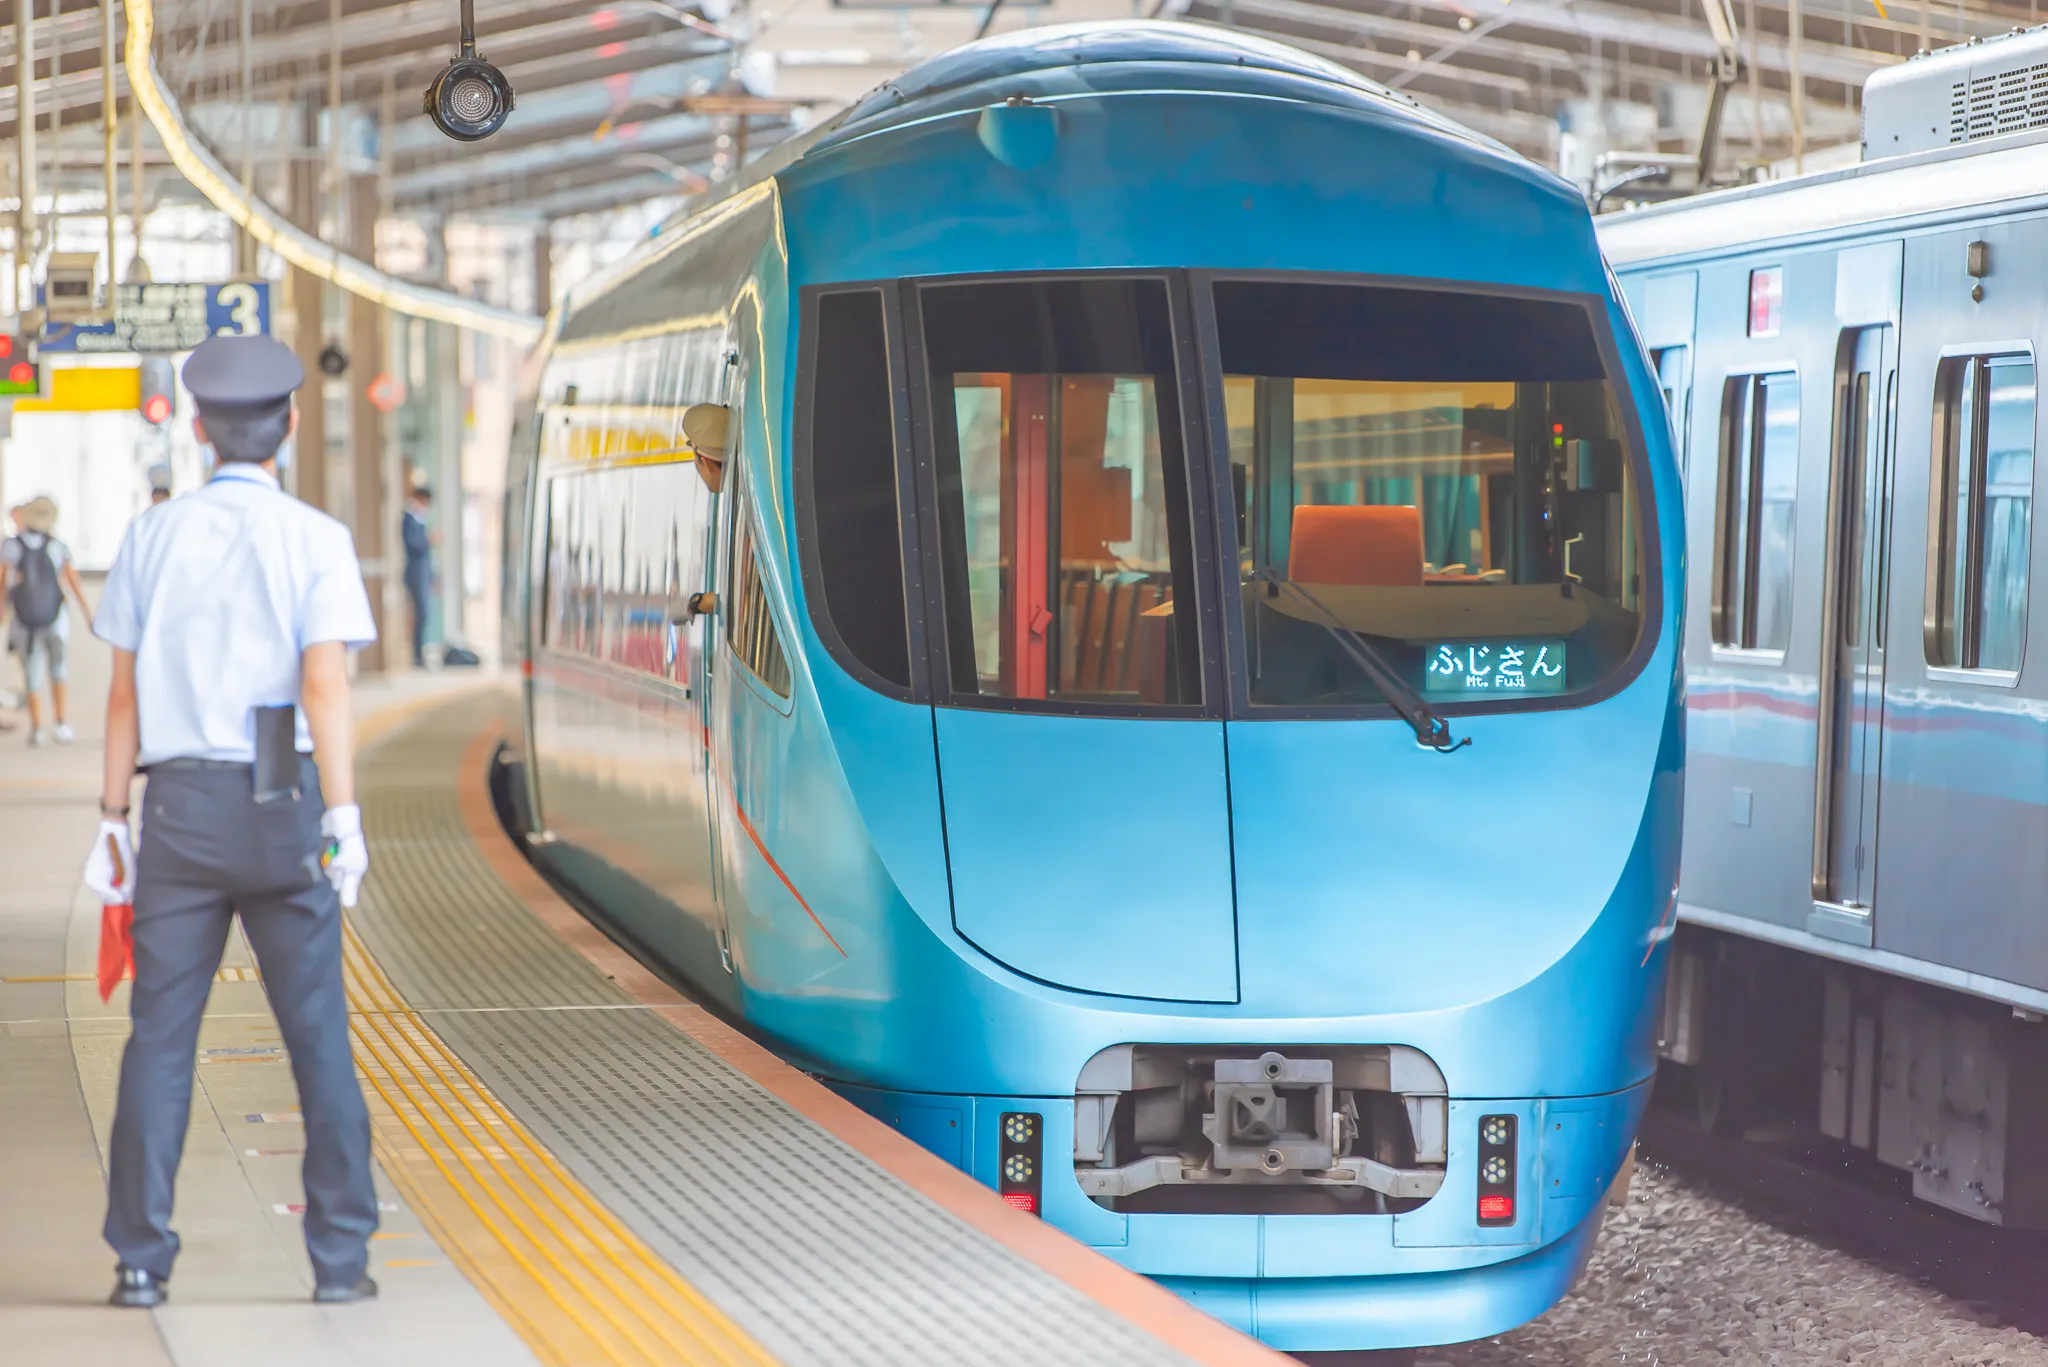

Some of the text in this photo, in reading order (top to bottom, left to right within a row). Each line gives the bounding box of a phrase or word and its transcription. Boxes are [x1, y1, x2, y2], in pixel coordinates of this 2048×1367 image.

[216, 283, 261, 337] 3
[1429, 645, 1562, 676] ふじさん
[1466, 675, 1526, 687] Mt. Fuji
